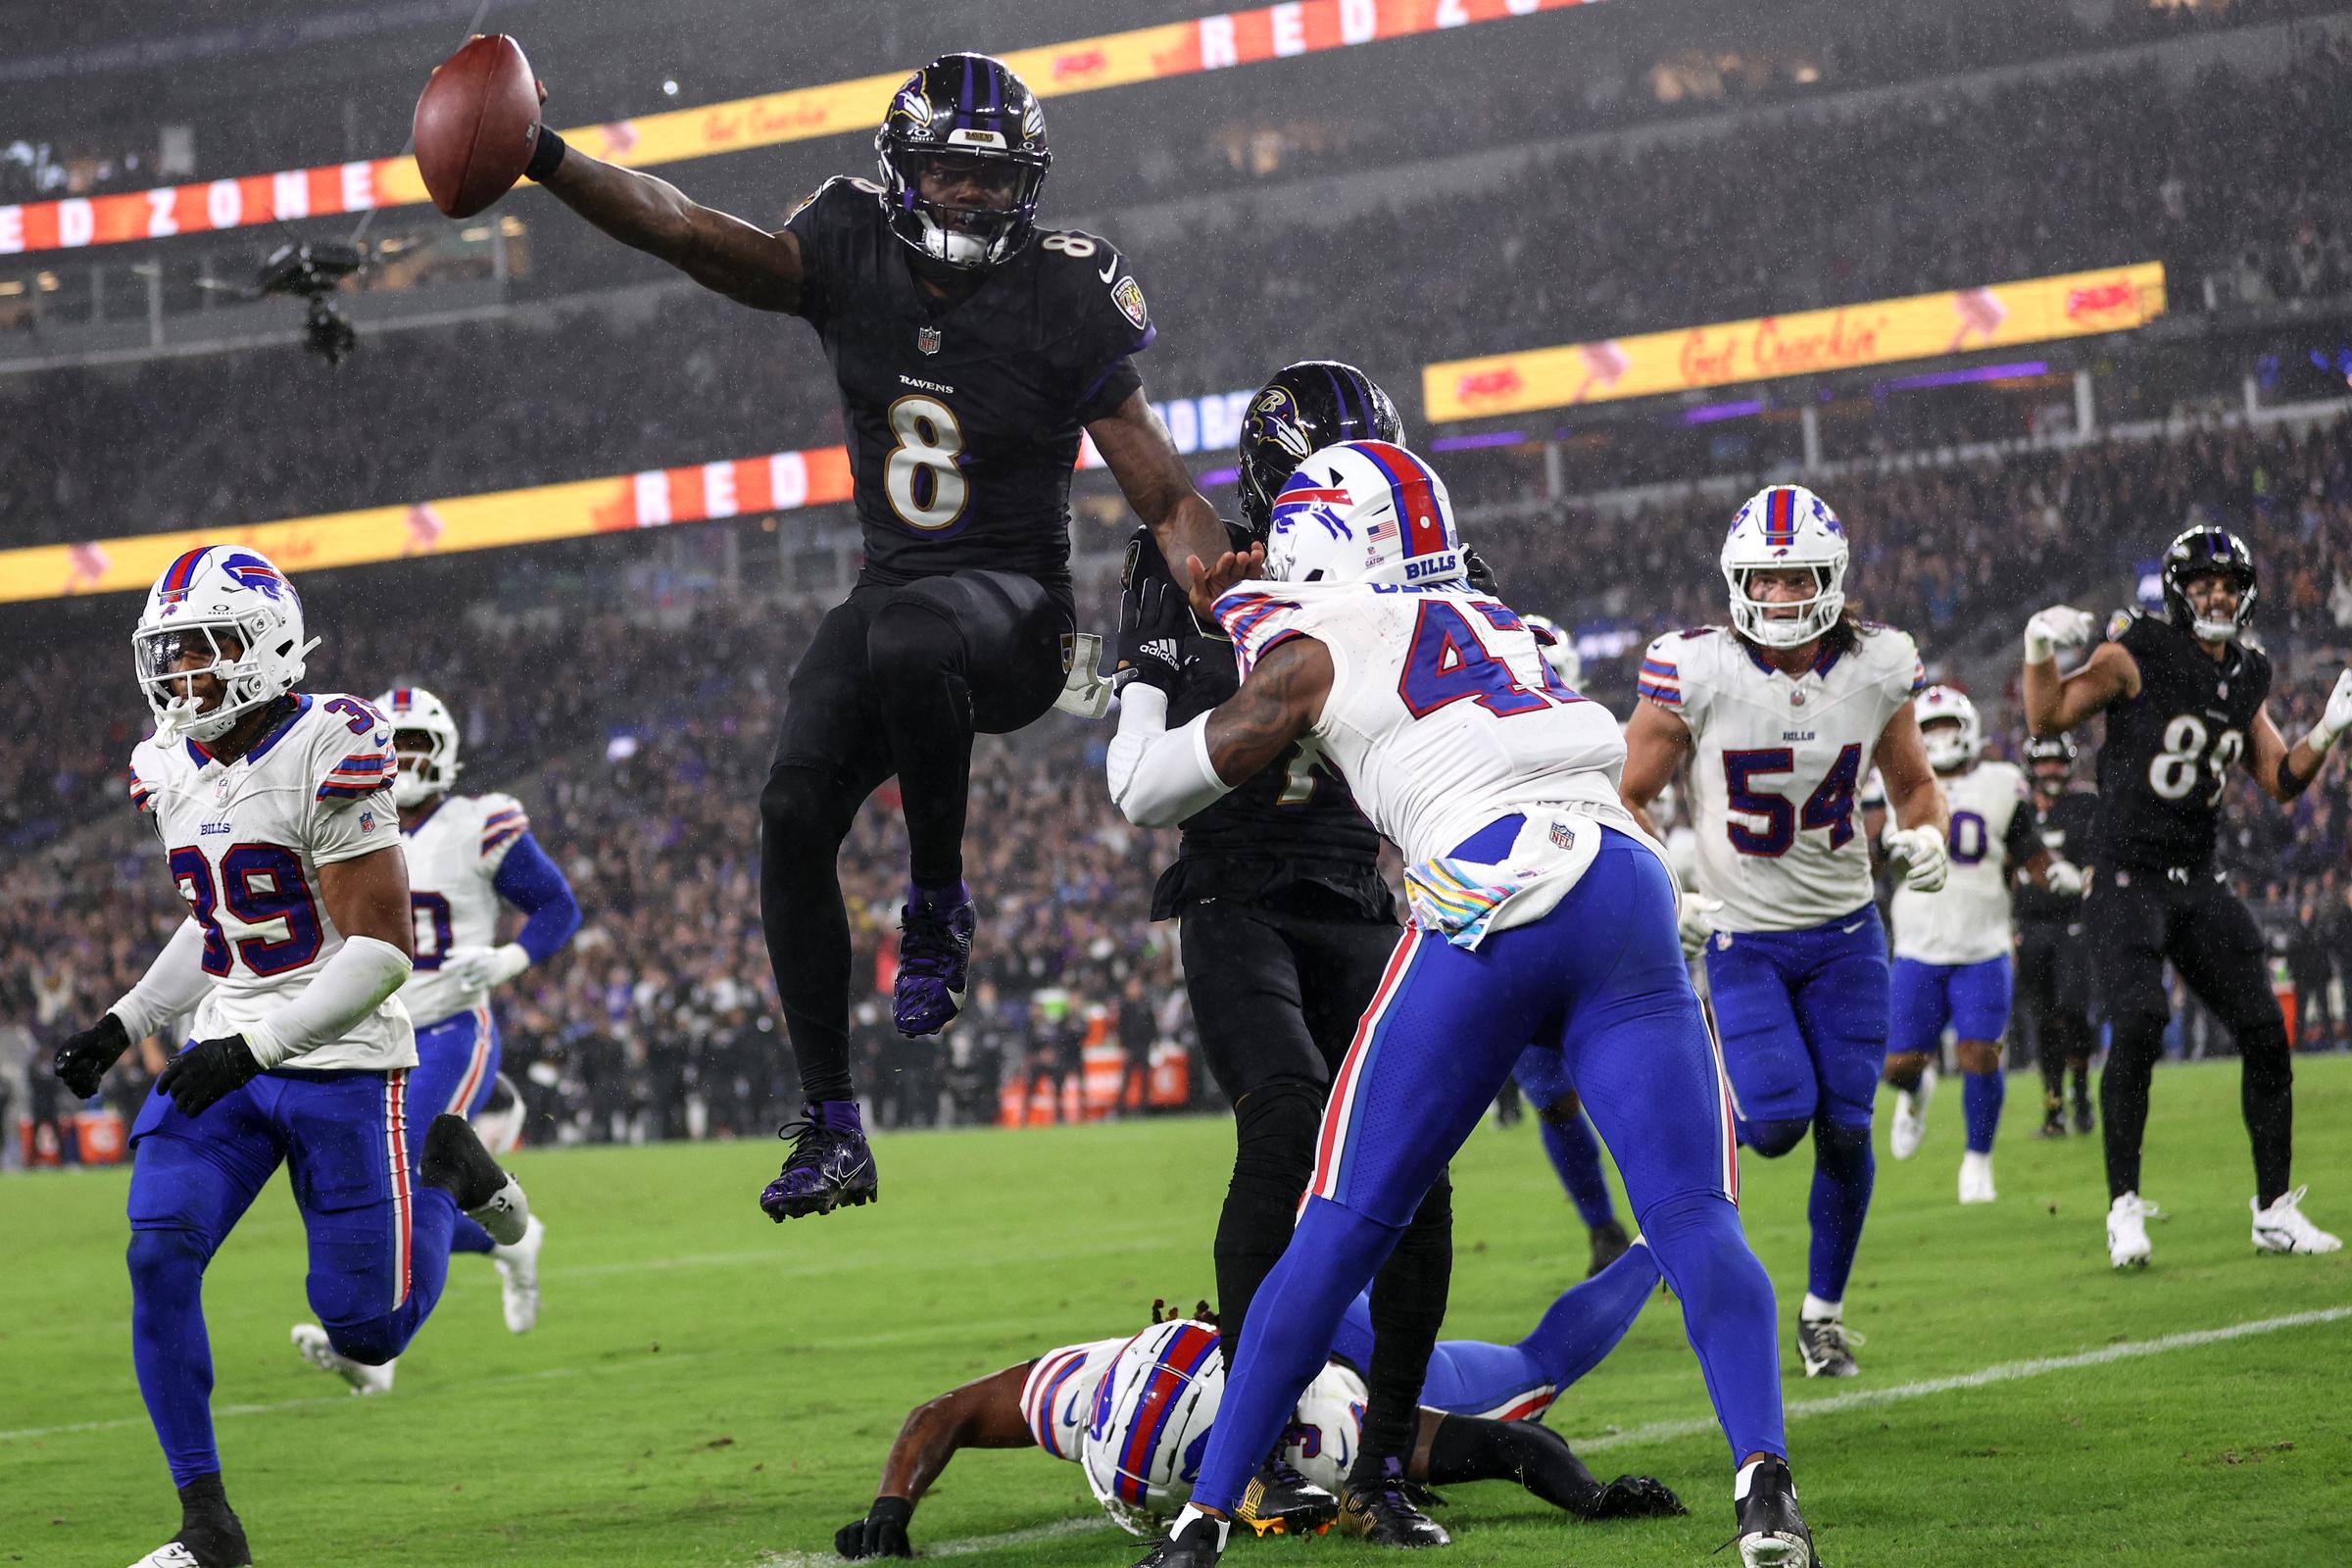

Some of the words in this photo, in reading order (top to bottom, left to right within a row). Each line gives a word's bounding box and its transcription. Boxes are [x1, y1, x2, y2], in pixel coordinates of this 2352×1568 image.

[1200, 0, 1375, 70] RED
[146, 161, 377, 239] ZONE
[1042, 235, 1096, 258] 8
[899, 374, 955, 394] RAVENS
[884, 394, 969, 530] 8
[634, 451, 809, 528] RED
[1405, 555, 1456, 580] BILLS
[1139, 643, 1180, 671] adidas
[1783, 731, 1815, 741] BILLS
[1722, 742, 1862, 858] 54
[200, 822, 231, 836] BILLS
[1551, 831, 1571, 849] NFL
